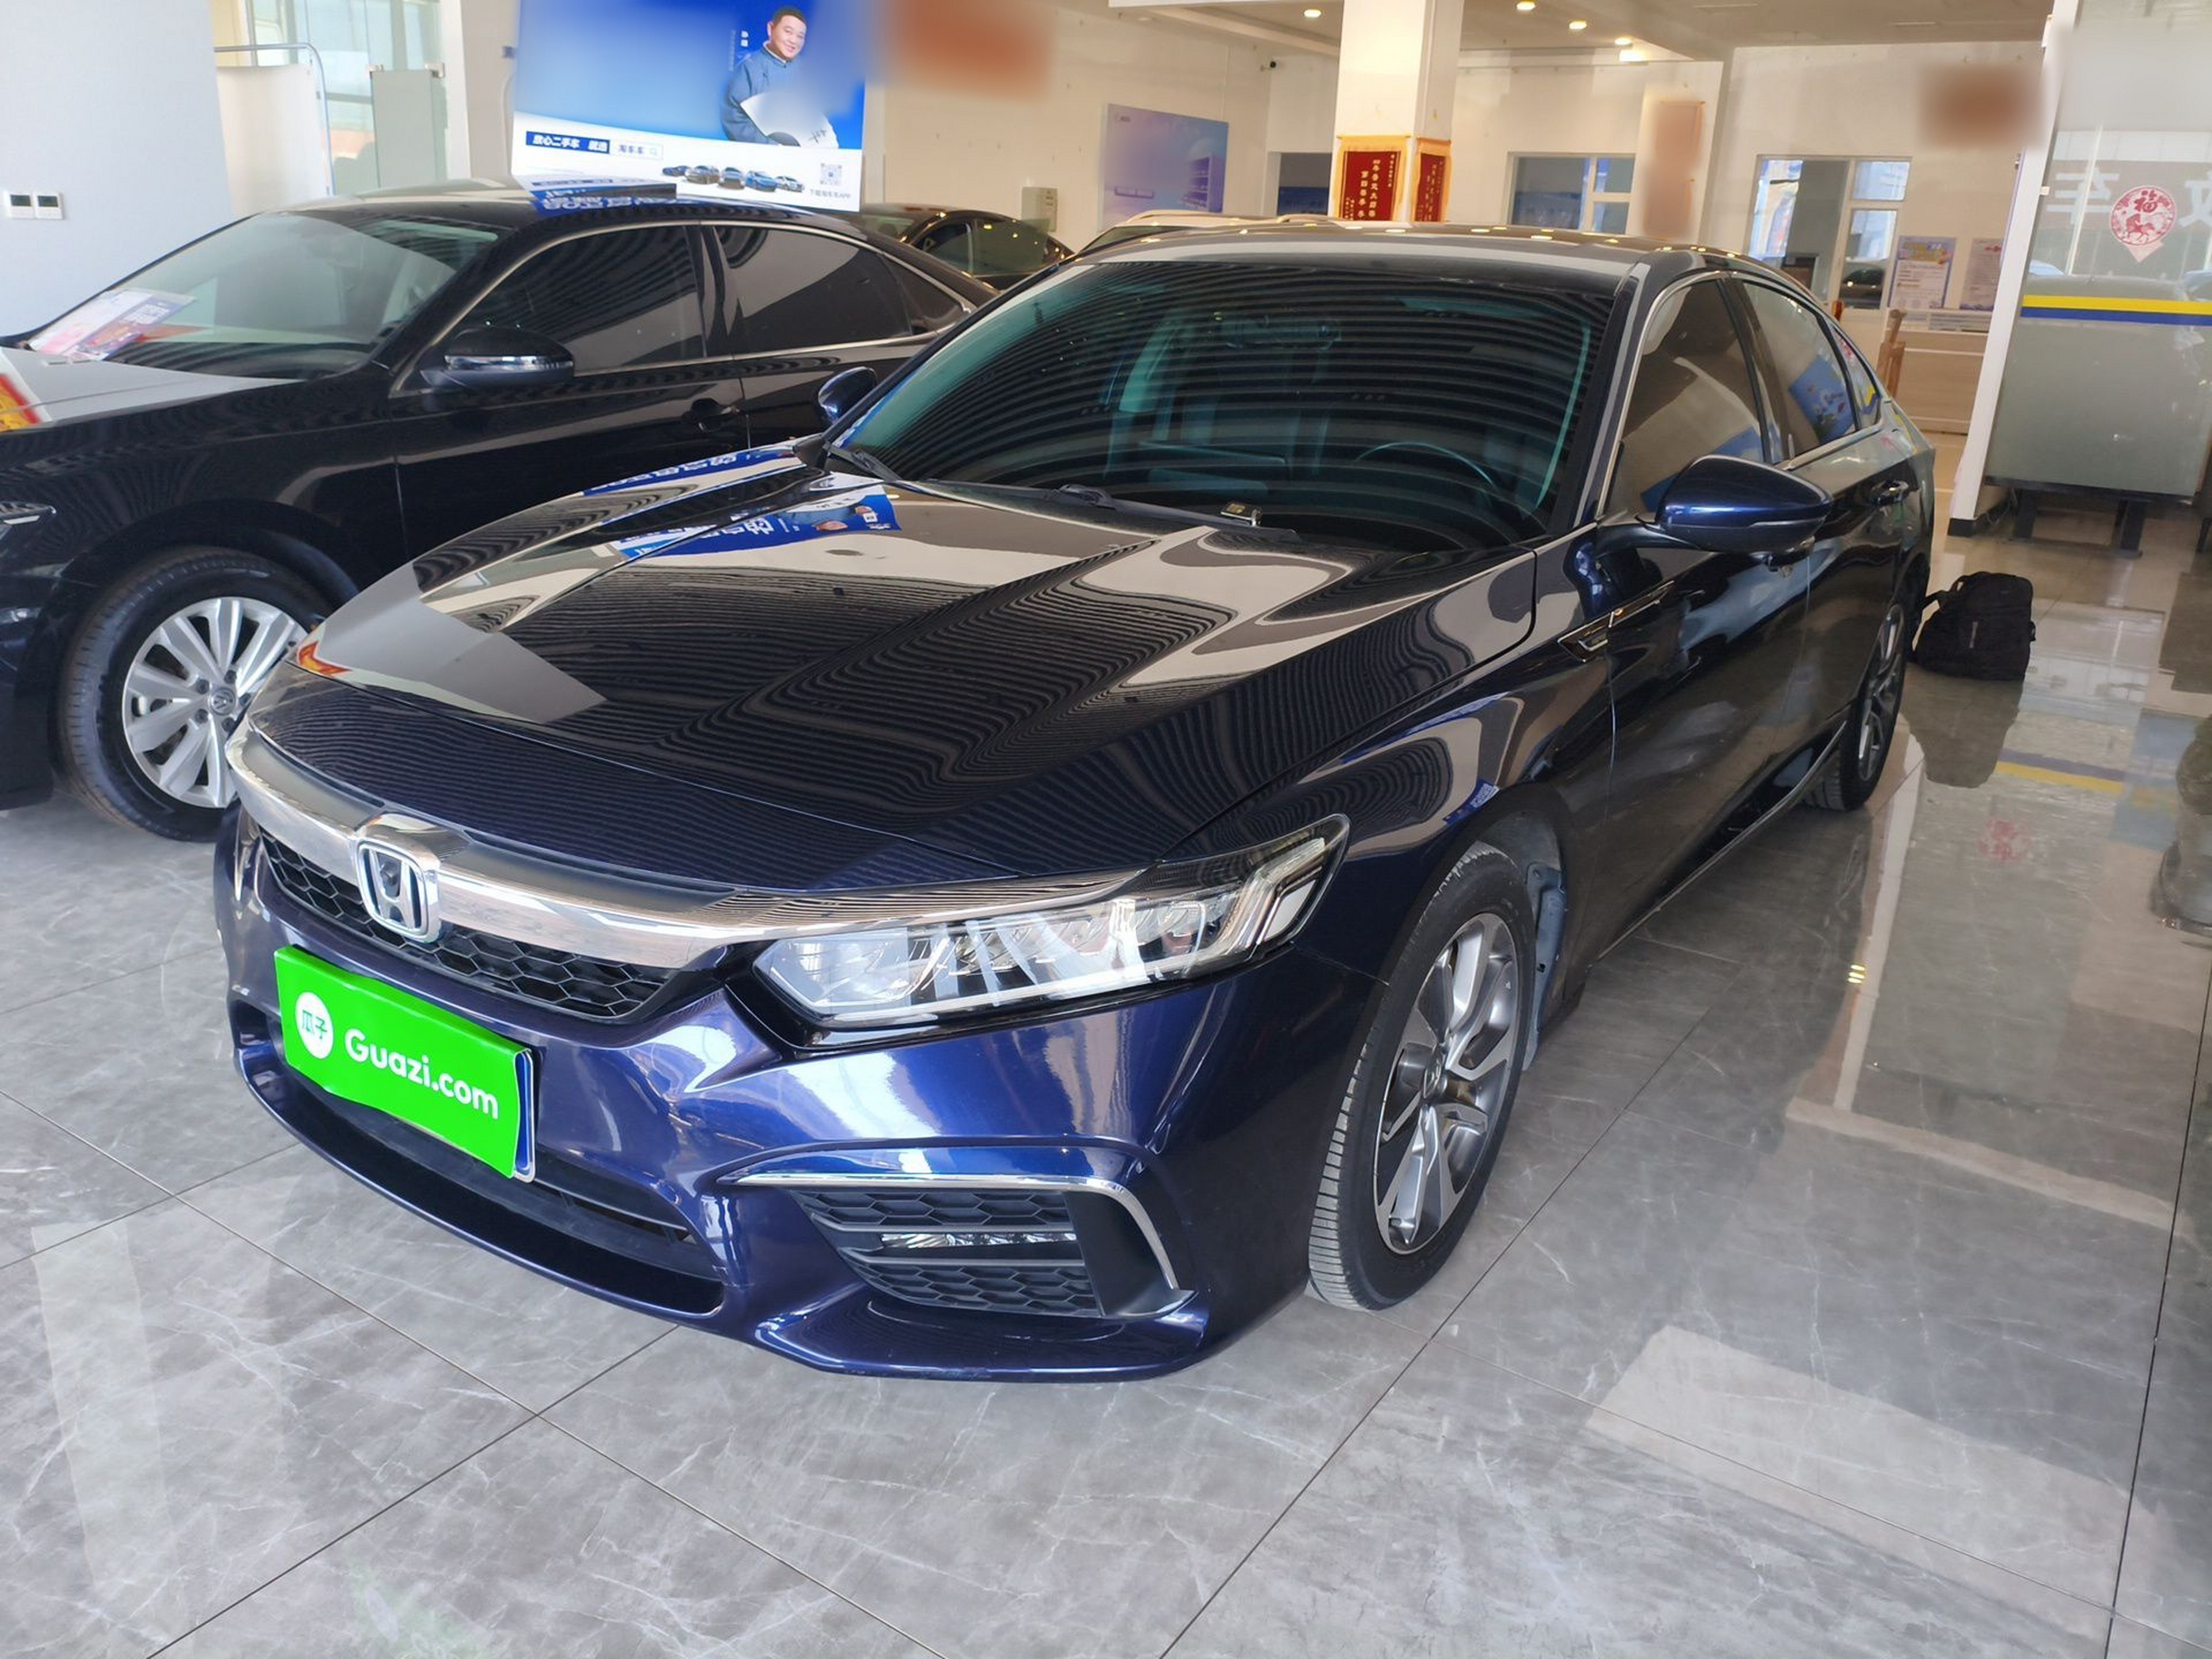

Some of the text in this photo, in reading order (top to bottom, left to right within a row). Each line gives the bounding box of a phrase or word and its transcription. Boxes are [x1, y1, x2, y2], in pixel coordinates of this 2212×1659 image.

[2134, 189, 2158, 213] 福
[301, 1008, 328, 1040] 瓜子
[345, 1028, 499, 1119] Guazi.com
